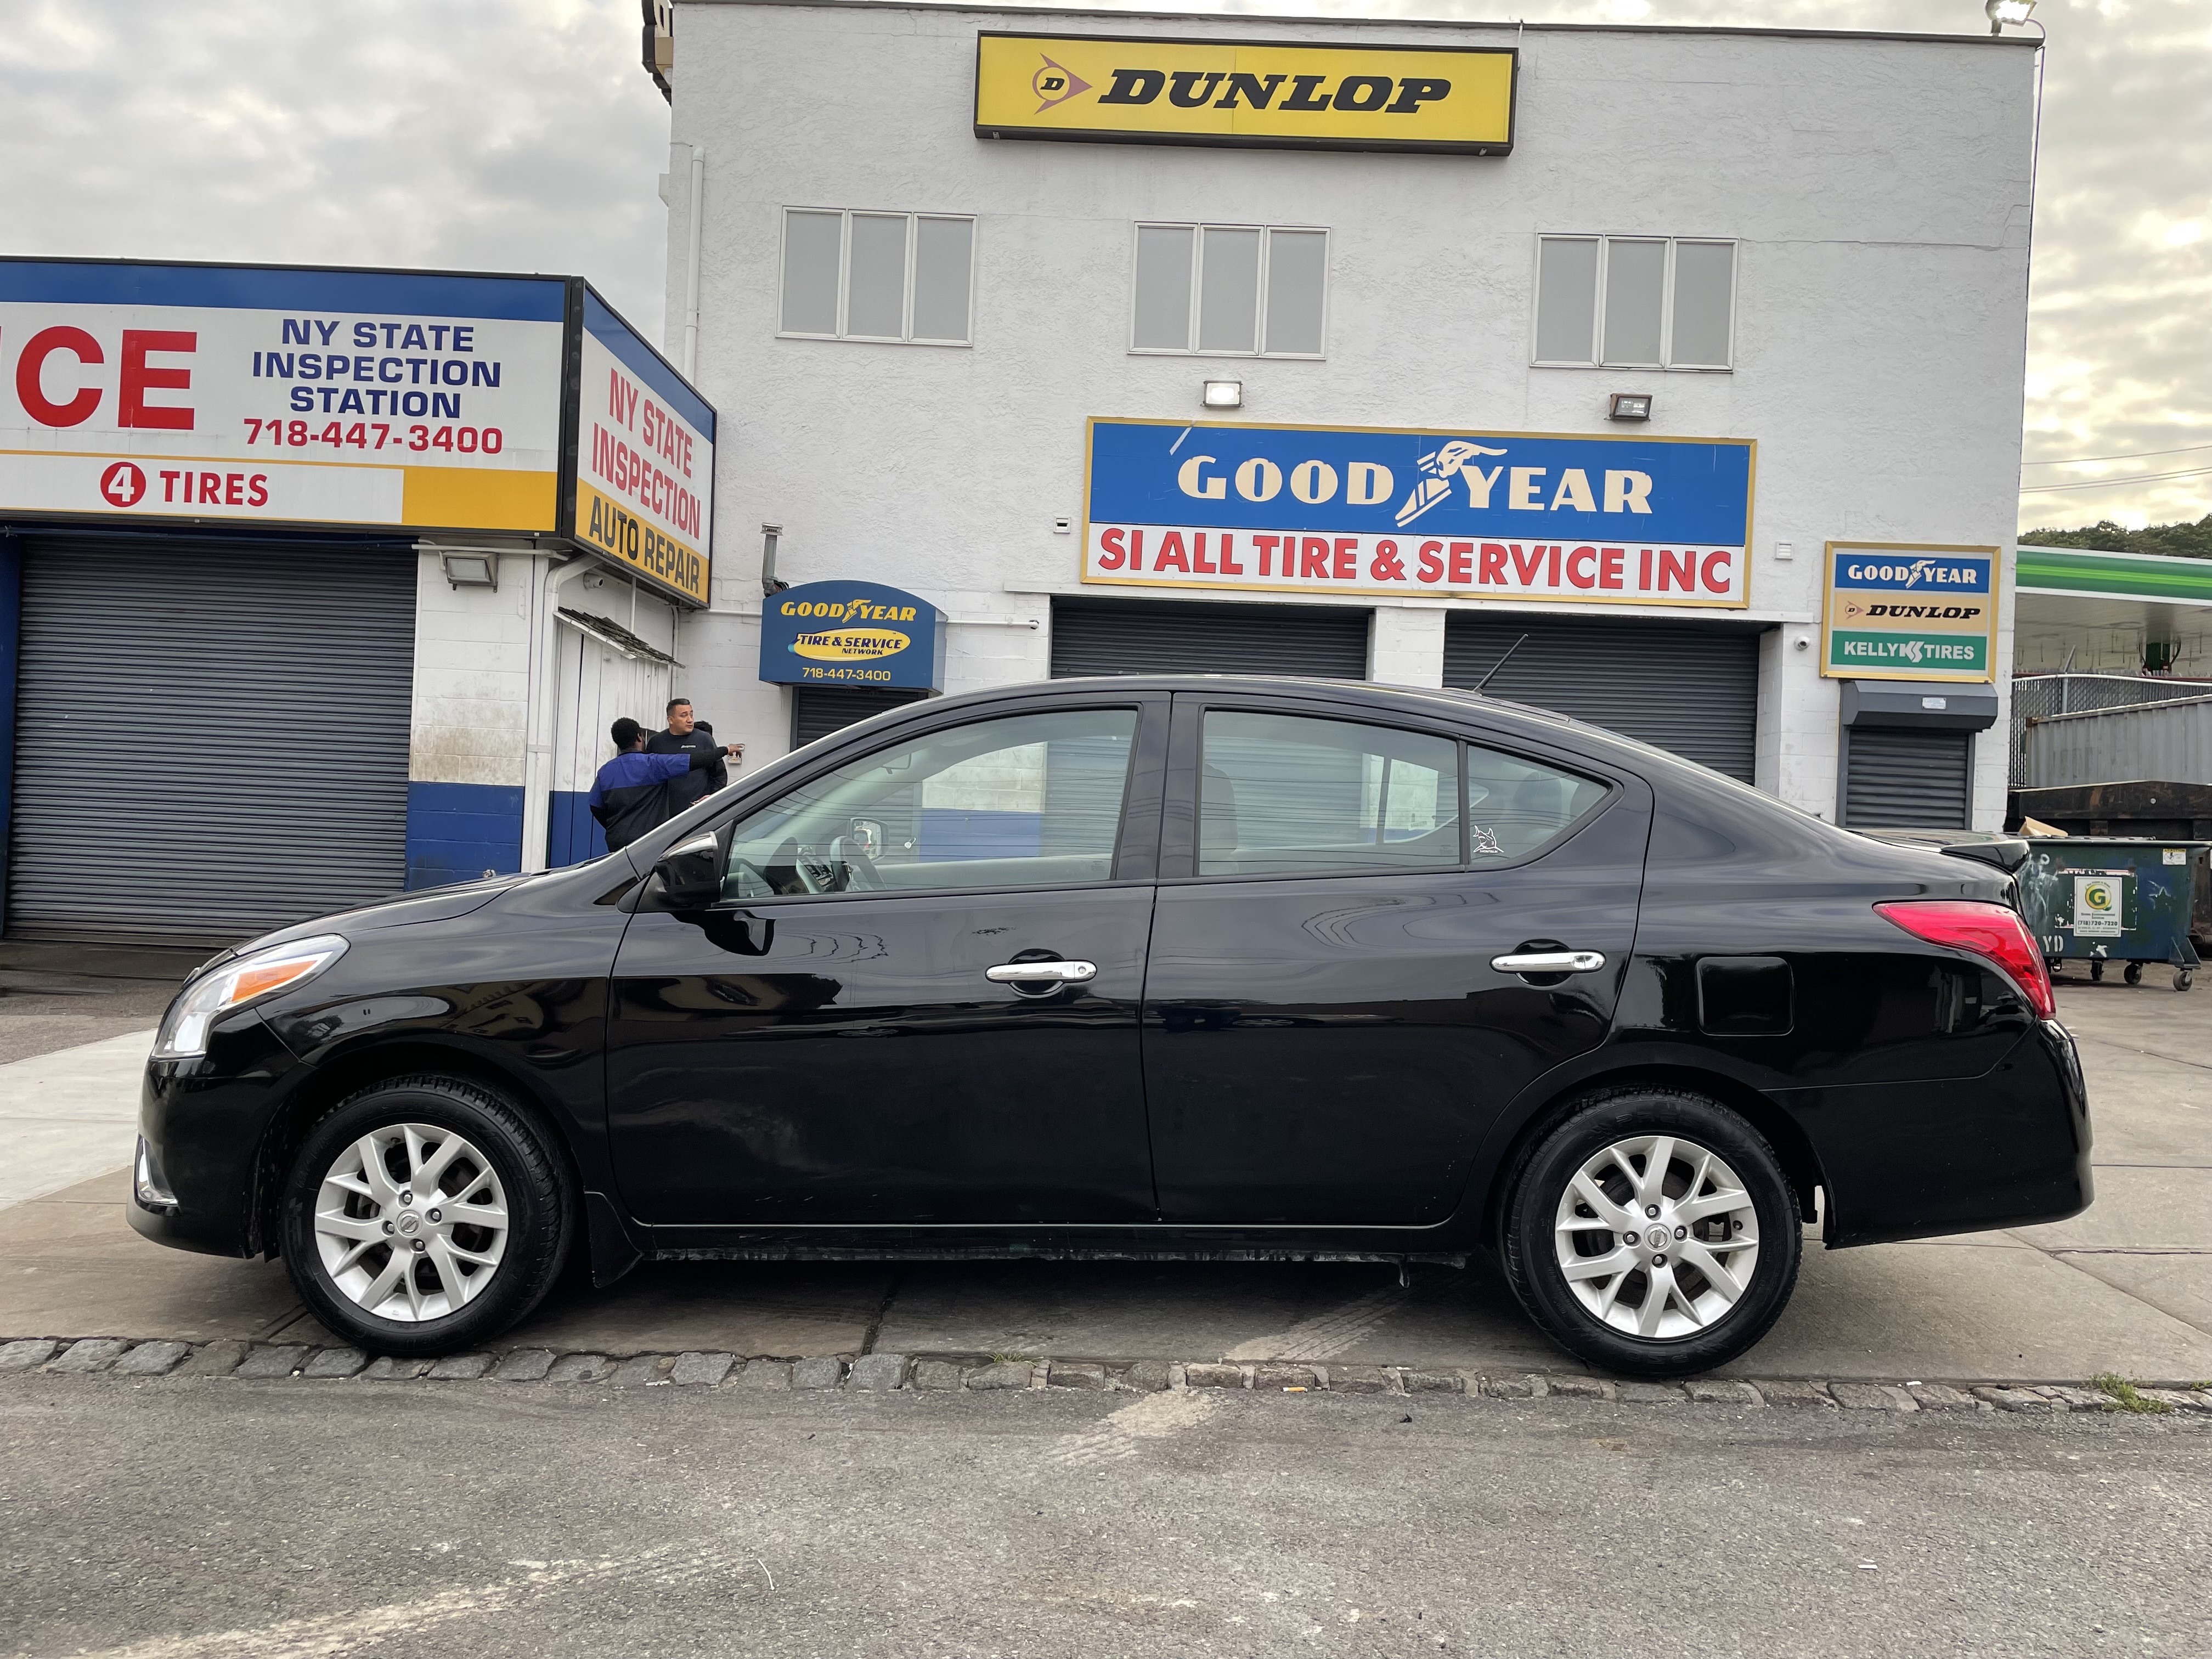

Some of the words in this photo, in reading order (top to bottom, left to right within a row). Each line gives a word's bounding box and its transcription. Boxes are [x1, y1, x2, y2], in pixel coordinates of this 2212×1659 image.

[1040, 77, 1065, 91] D
[1097, 69, 1452, 114] DUNLOP
[283, 319, 338, 346] NY
[354, 322, 473, 352] STATE
[0, 326, 196, 430] CE
[253, 352, 500, 387] INSPECTION
[291, 386, 460, 418] STATION
[245, 419, 503, 456] 718-447-3400
[610, 367, 639, 432] NY
[643, 399, 692, 479] STATE
[159, 471, 268, 507] TIRES
[592, 421, 701, 540] INSPECTION
[589, 495, 639, 561] AUTO
[644, 527, 699, 594] REPAIR
[1099, 528, 1143, 571] SI
[1154, 532, 1243, 574] ALL
[1253, 535, 1357, 579] TIRE
[1370, 540, 1405, 581] &
[1417, 541, 1624, 589] SERVICE
[1639, 550, 1730, 593] INC
[1866, 605, 1981, 619] DUNLOP
[799, 635, 831, 645] TIRE
[831, 637, 843, 646] &
[845, 637, 902, 649] SERVICE
[1844, 641, 1899, 657] KELLY
[1923, 644, 1974, 659] TIRES
[802, 667, 891, 681] 718-447-3400
[2042, 935, 2064, 952] YD
